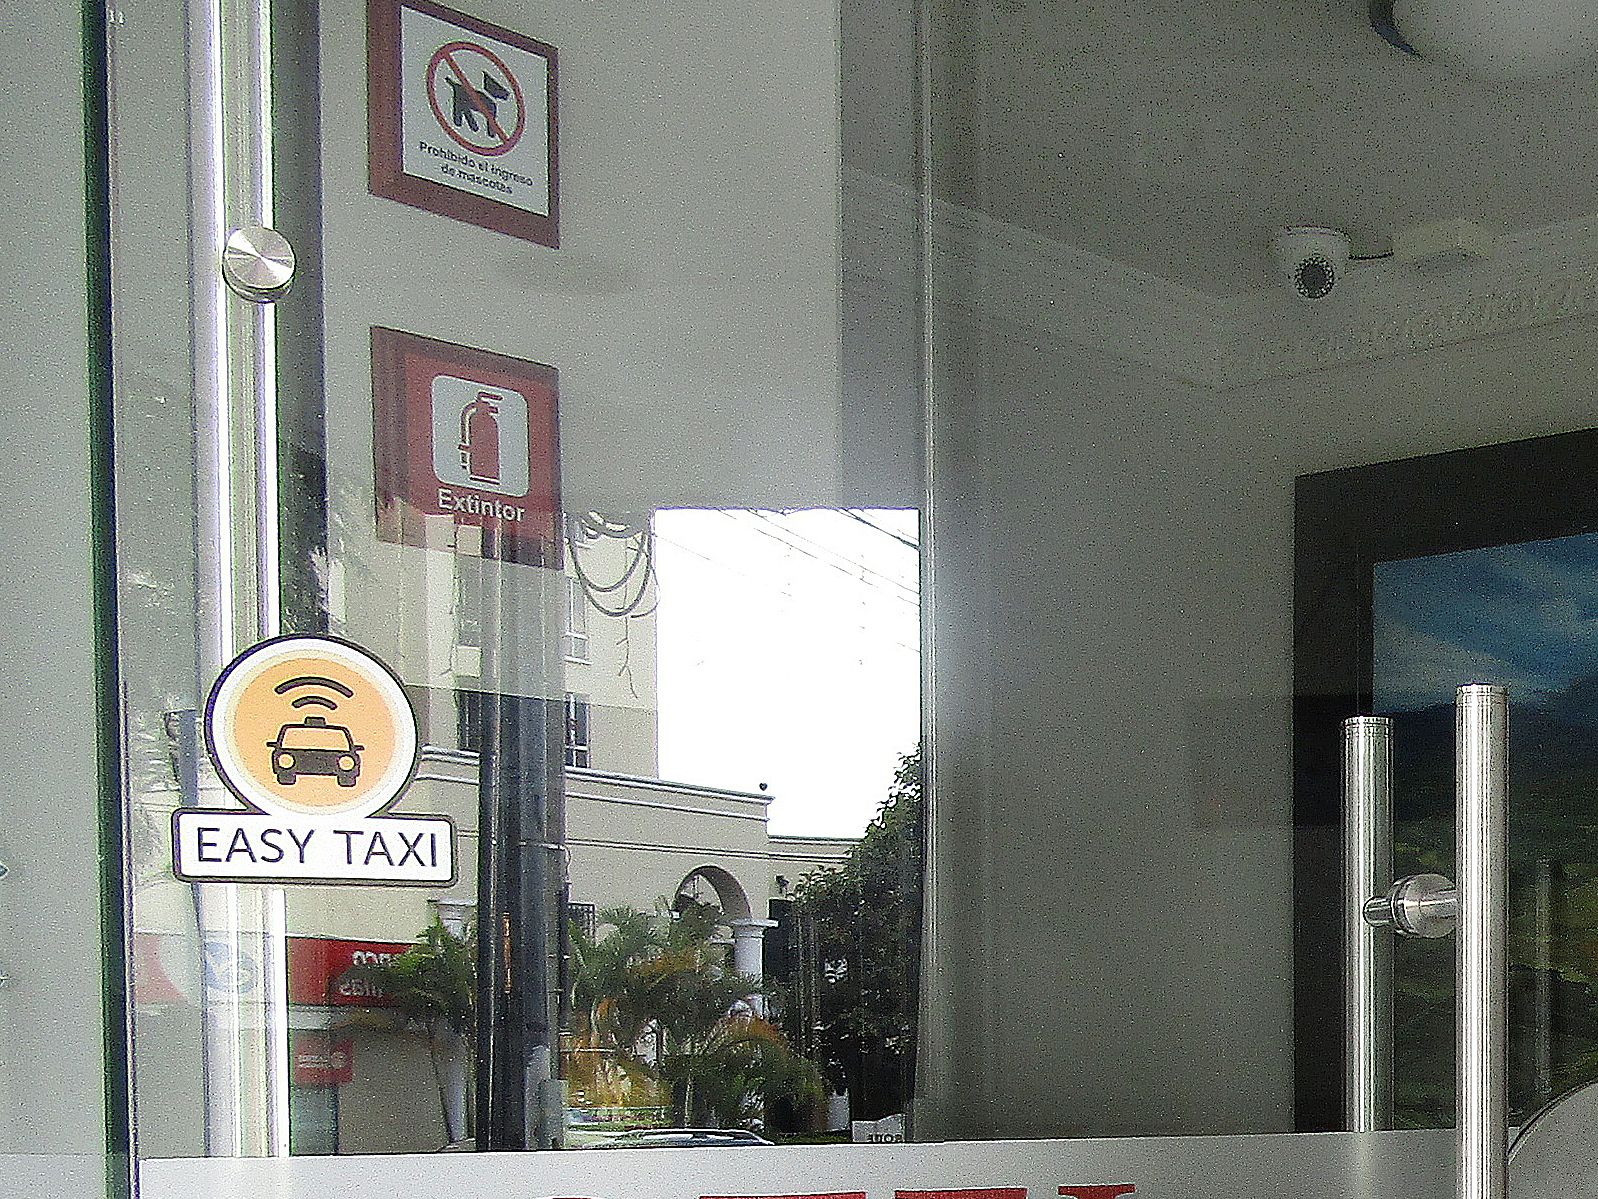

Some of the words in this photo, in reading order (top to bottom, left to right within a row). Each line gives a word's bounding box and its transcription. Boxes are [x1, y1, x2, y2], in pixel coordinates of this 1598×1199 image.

[419, 140, 476, 168] Prohibido
[478, 159, 489, 172] el
[490, 163, 534, 187] ingreso
[440, 163, 456, 178] de
[457, 169, 514, 195] mascotas
[438, 487, 526, 522] Extintor
[196, 826, 317, 865] EASY
[332, 829, 439, 868] TAXI
